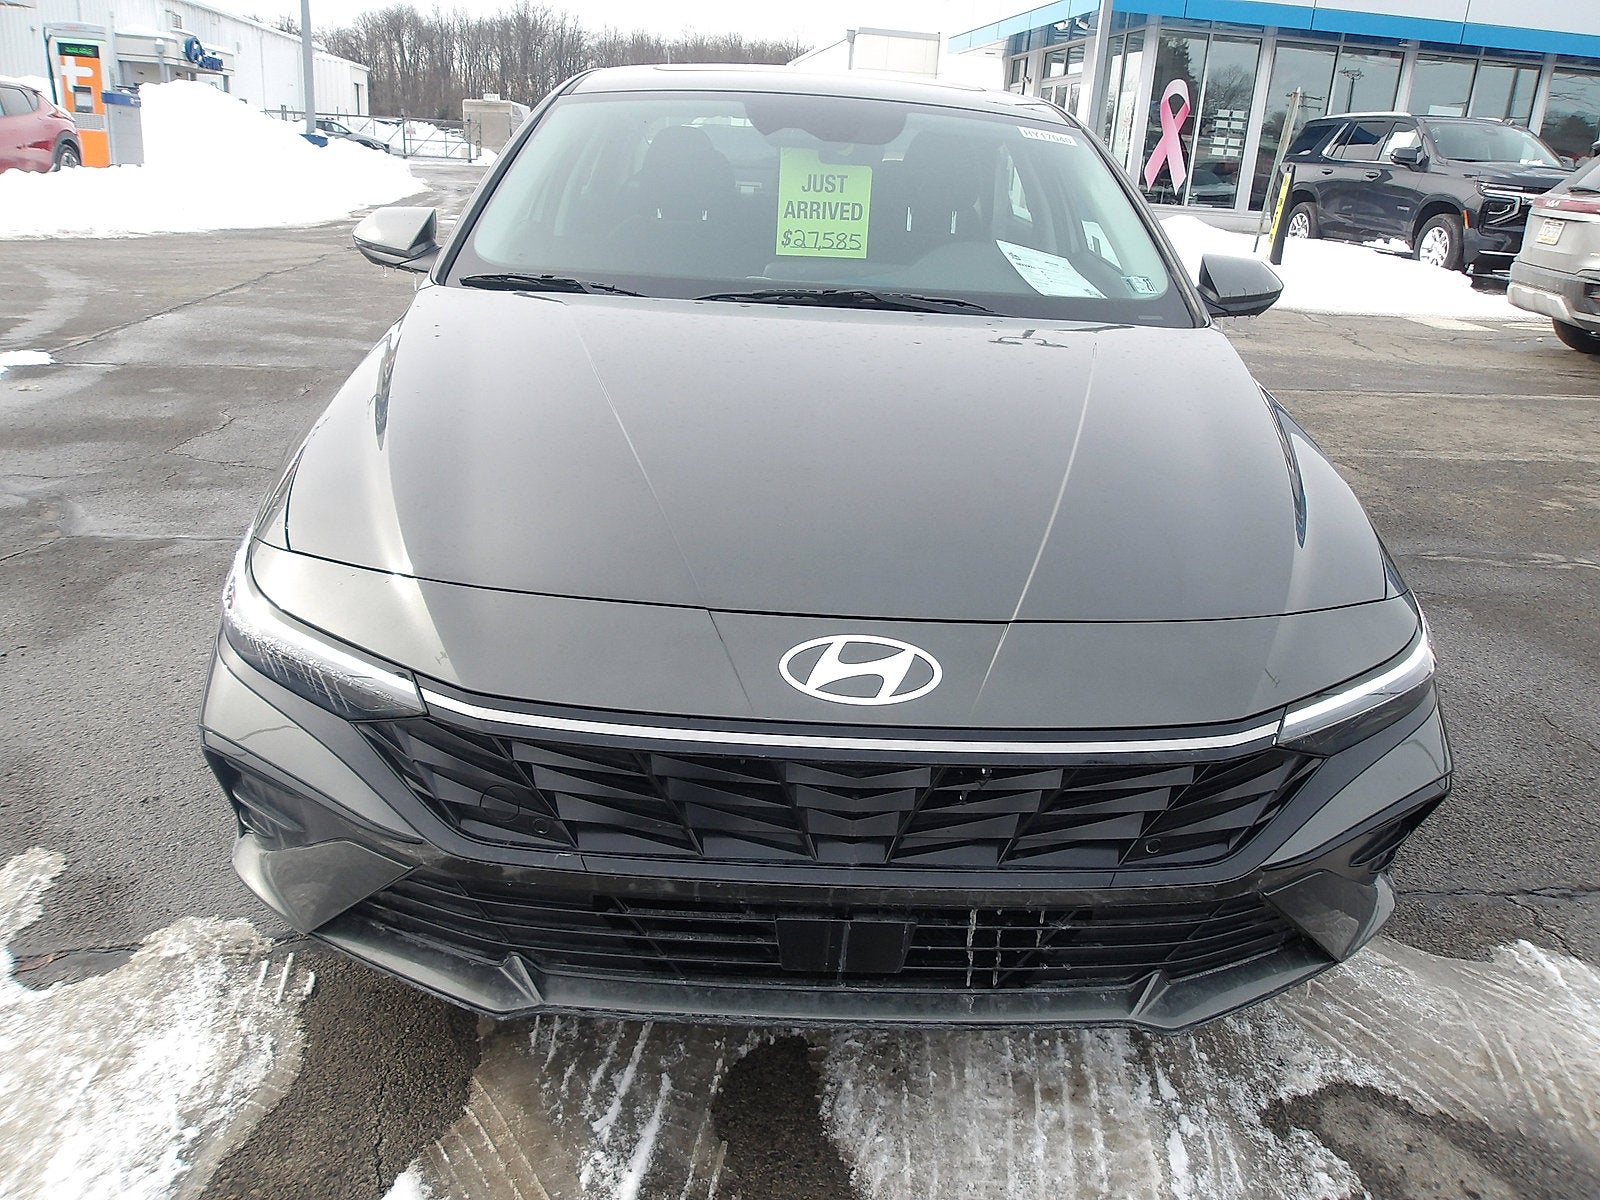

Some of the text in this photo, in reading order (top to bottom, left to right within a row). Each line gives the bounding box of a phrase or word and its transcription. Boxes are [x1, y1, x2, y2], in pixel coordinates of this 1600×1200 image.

[801, 174, 848, 193] JUST
[783, 200, 863, 221] ARRIVED
[781, 229, 861, 251] $27,585
